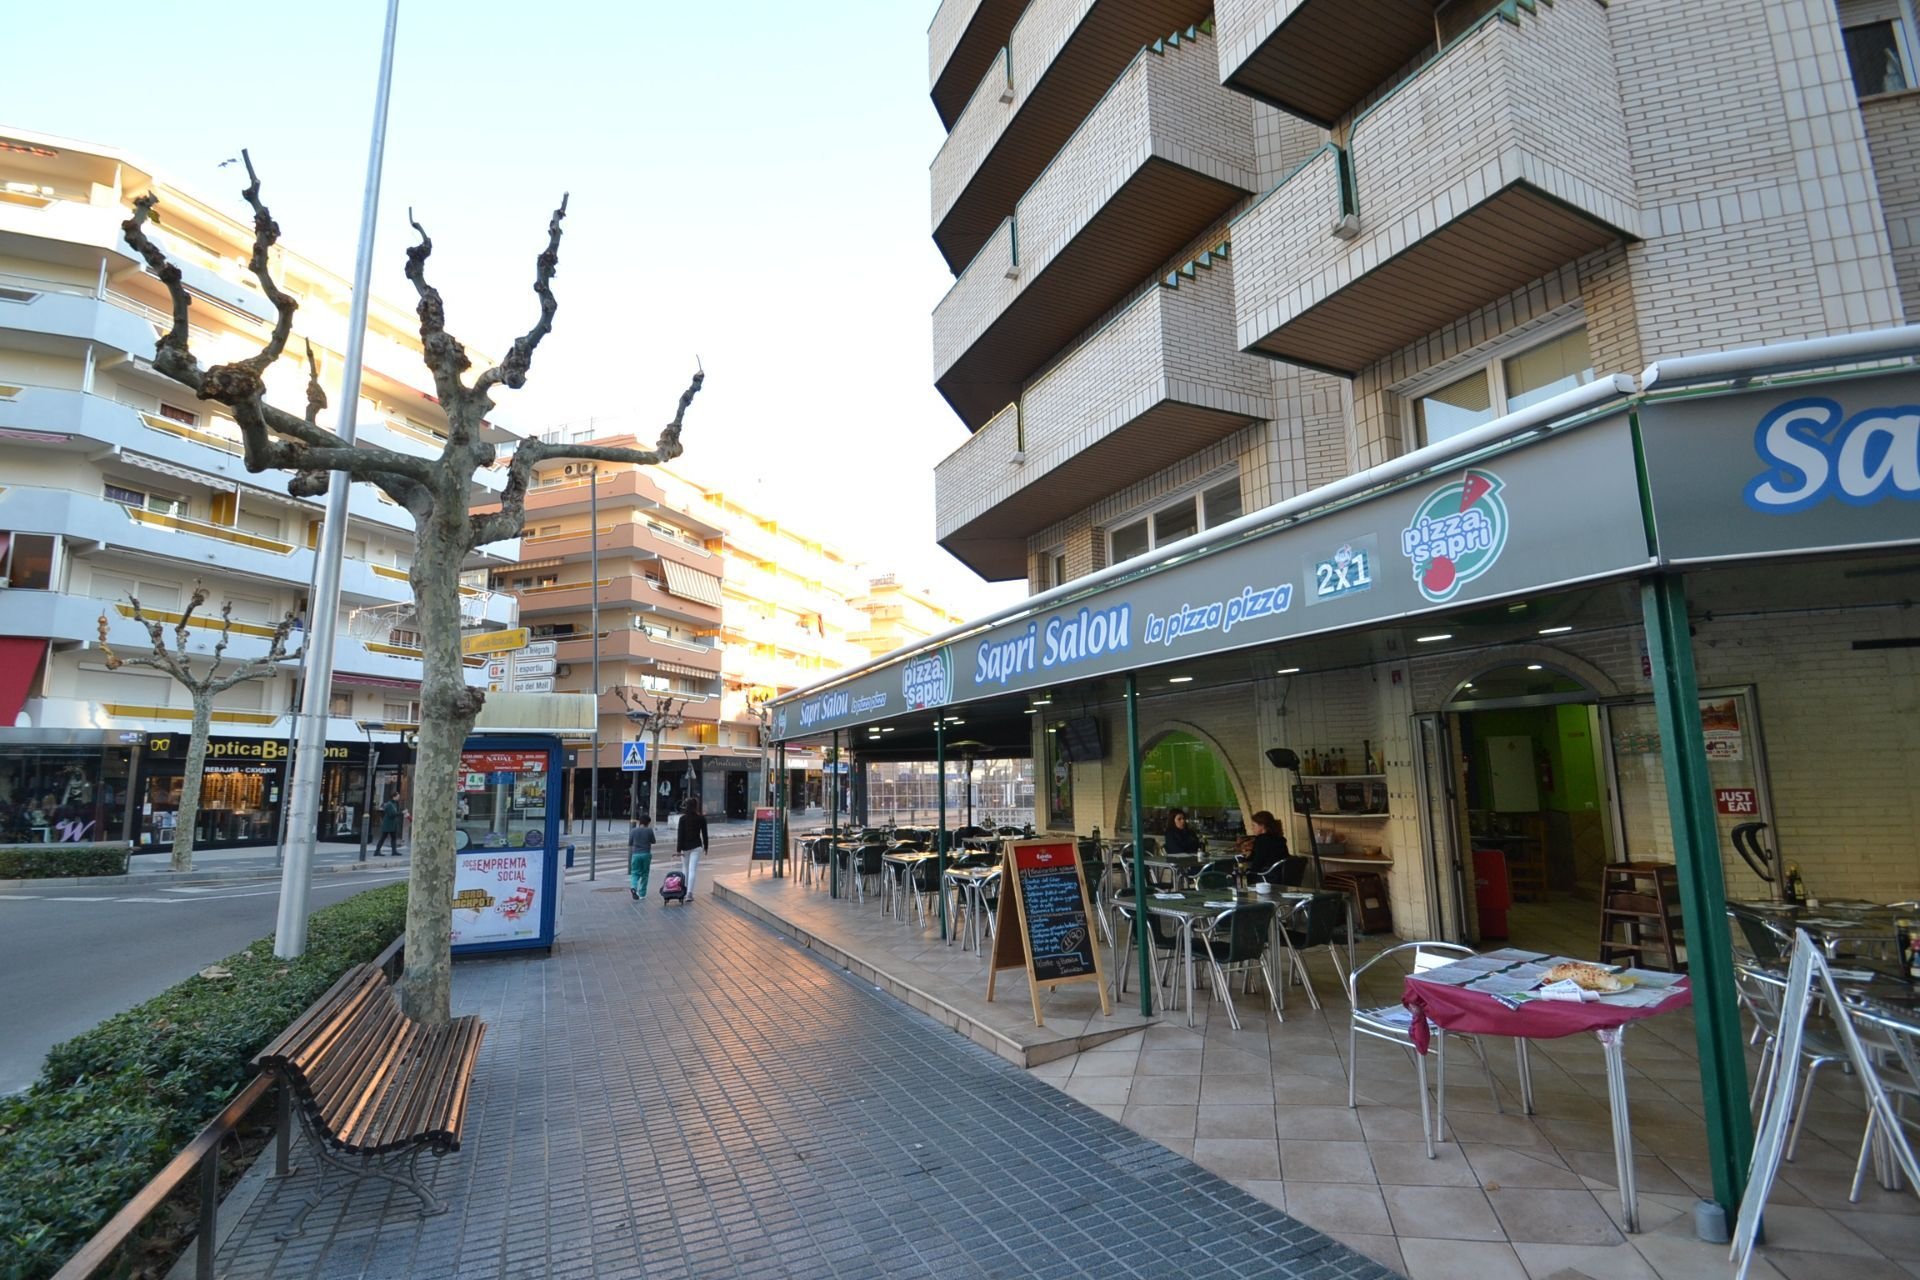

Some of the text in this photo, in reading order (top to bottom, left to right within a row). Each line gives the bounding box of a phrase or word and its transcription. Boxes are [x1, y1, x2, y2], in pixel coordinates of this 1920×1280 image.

[1404, 511, 1481, 554] pizza
[1414, 519, 1489, 562] sapri
[1316, 554, 1372, 595] 2x1
[974, 583, 1293, 685] Sapri Salou la pizza pizza
[903, 657, 942, 693] pizza
[908, 671, 945, 708] sapri
[821, 691, 849, 720] Salou
[204, 766, 239, 774] REBAJAS
[1719, 791, 1752, 801] JUST
[1727, 801, 1753, 812] EAT
[477, 857, 527, 873] EMPREMTA
[497, 870, 526, 883] SOCIAL
